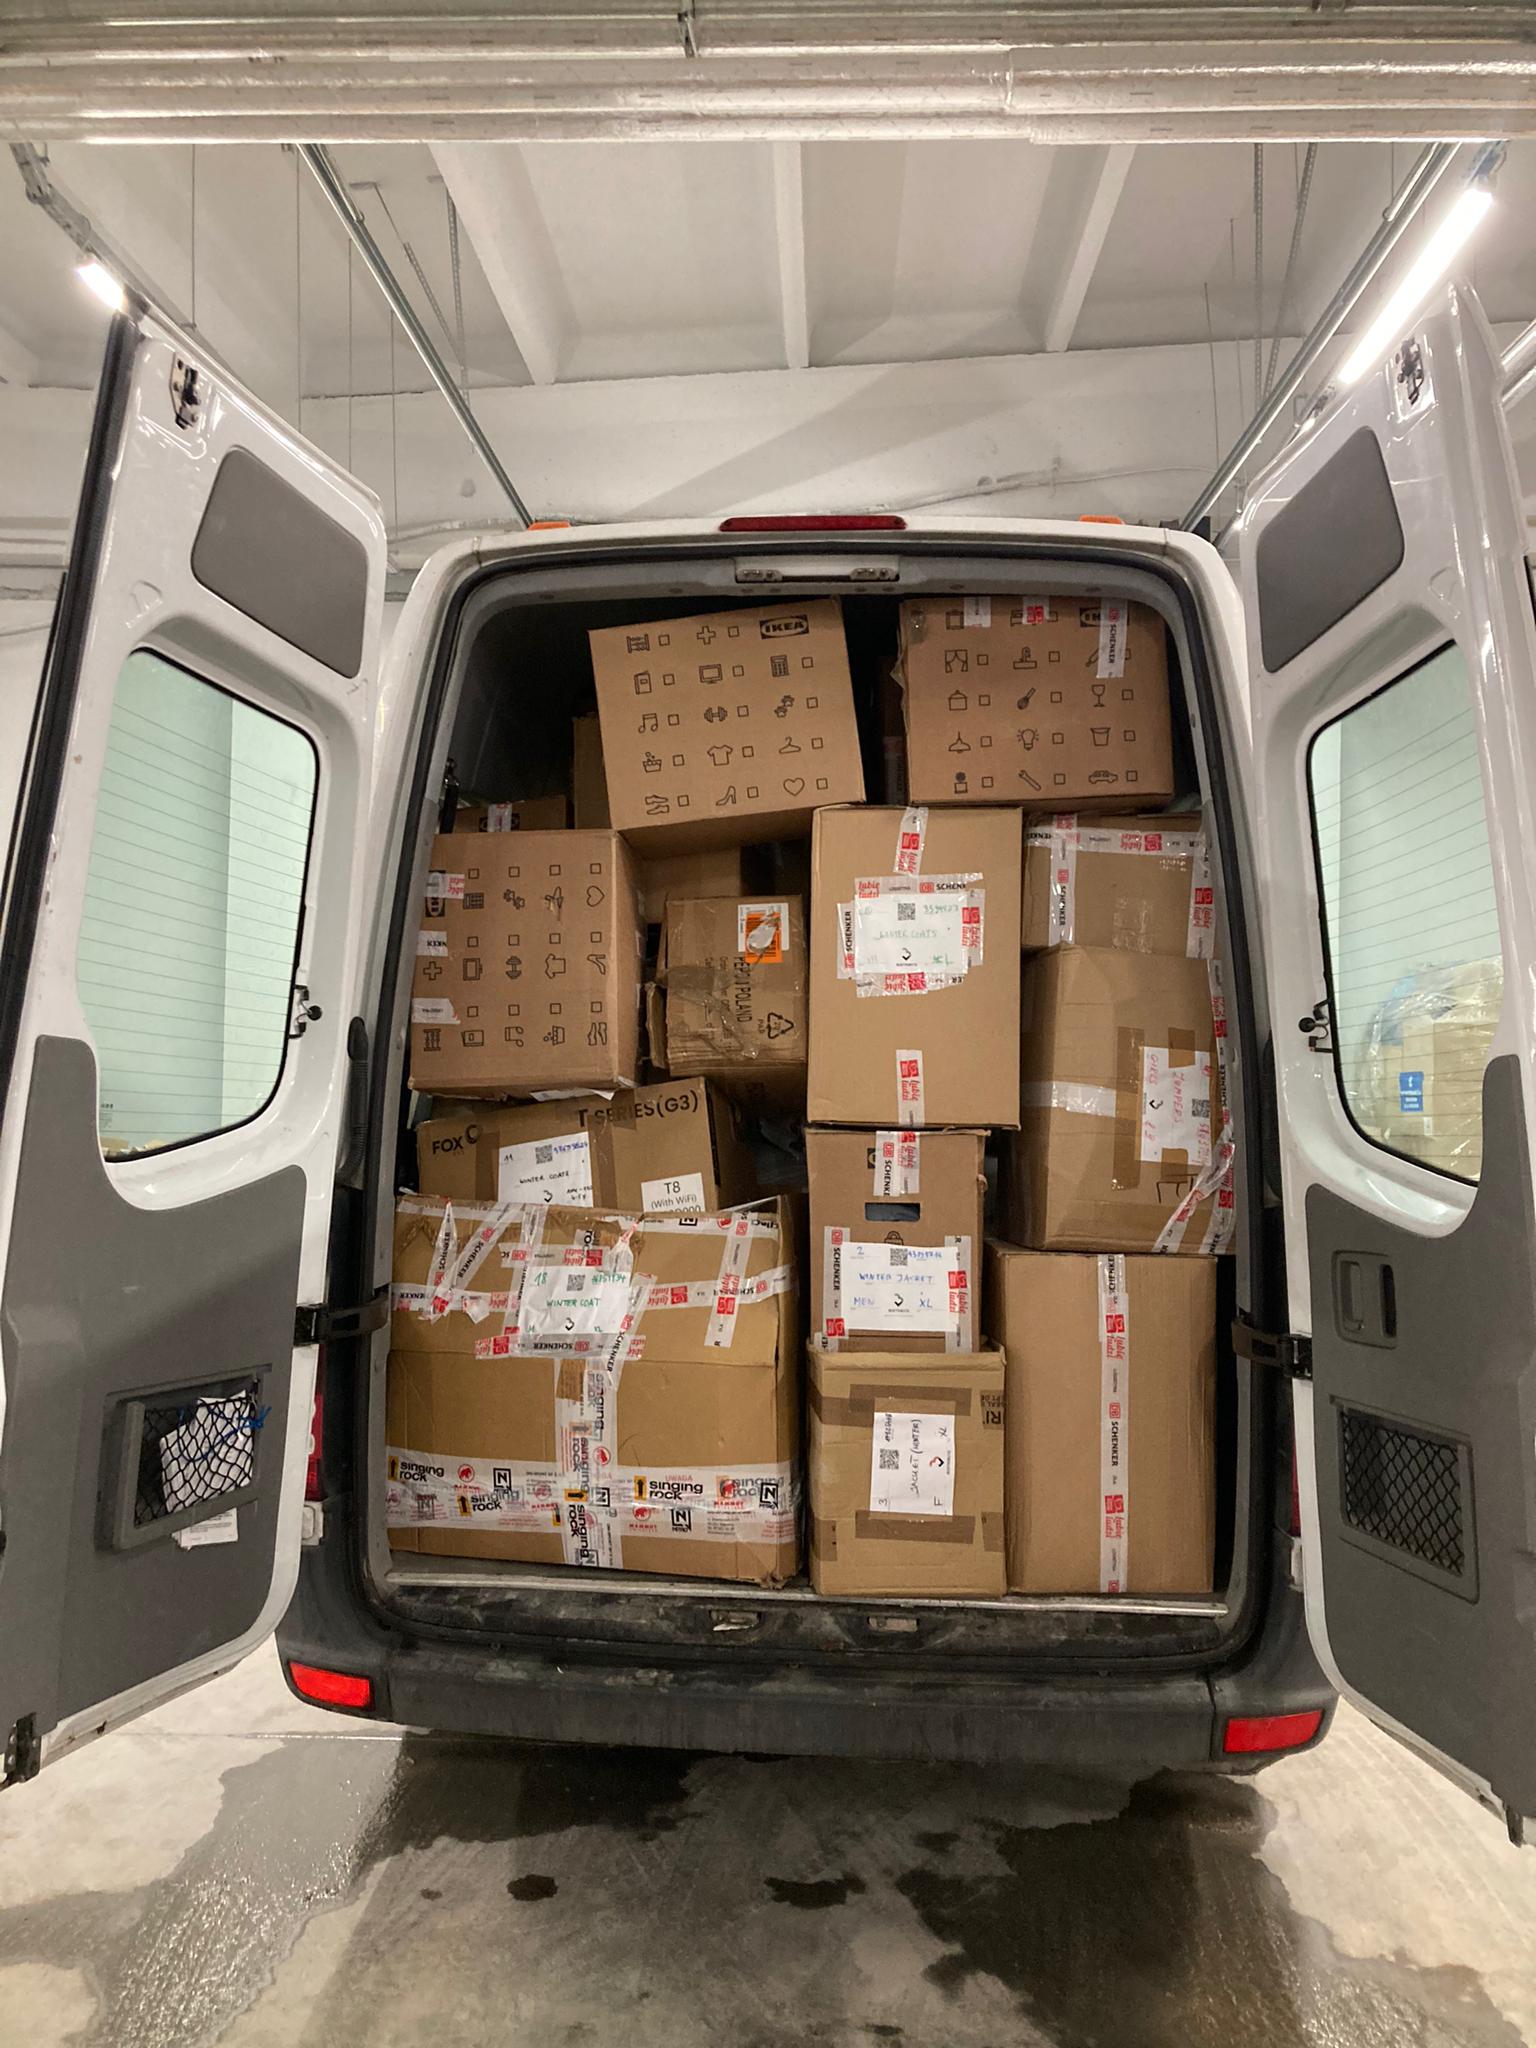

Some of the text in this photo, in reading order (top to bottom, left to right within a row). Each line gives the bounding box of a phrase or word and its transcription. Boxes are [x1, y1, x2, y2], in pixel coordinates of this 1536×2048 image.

[764, 620, 806, 634] IKEA
[1108, 624, 1117, 665] SCHENKER
[735, 987, 753, 1023] POLAND
[1172, 1072, 1185, 1124] JUMPERS
[578, 1089, 699, 1127] T SERIES(G3)
[432, 1135, 465, 1156] FOX
[519, 1175, 545, 1184] WINTER
[663, 1181, 681, 1194] T8
[651, 1198, 674, 1209] (With
[675, 1194, 697, 1206] WiFi)
[856, 1246, 865, 1255] 2
[457, 1241, 484, 1278] SCHENKER
[833, 1248, 841, 1291] SCHENKER
[533, 1271, 549, 1286] 18
[547, 1297, 600, 1308] WINTER COAT
[853, 1297, 875, 1307] MEN
[919, 1298, 933, 1309] XL
[533, 1342, 573, 1350] SCHENKER
[607, 1331, 625, 1372] SCHENKER
[1109, 1402, 1121, 1419] DB
[400, 1461, 445, 1477] singing
[399, 1471, 428, 1483] rock
[649, 1481, 703, 1494] singing
[649, 1490, 682, 1501] rock
[933, 1495, 943, 1507] F
[472, 1500, 503, 1512] rock
[568, 1504, 580, 1538] rock
[577, 1503, 591, 1559] singing
